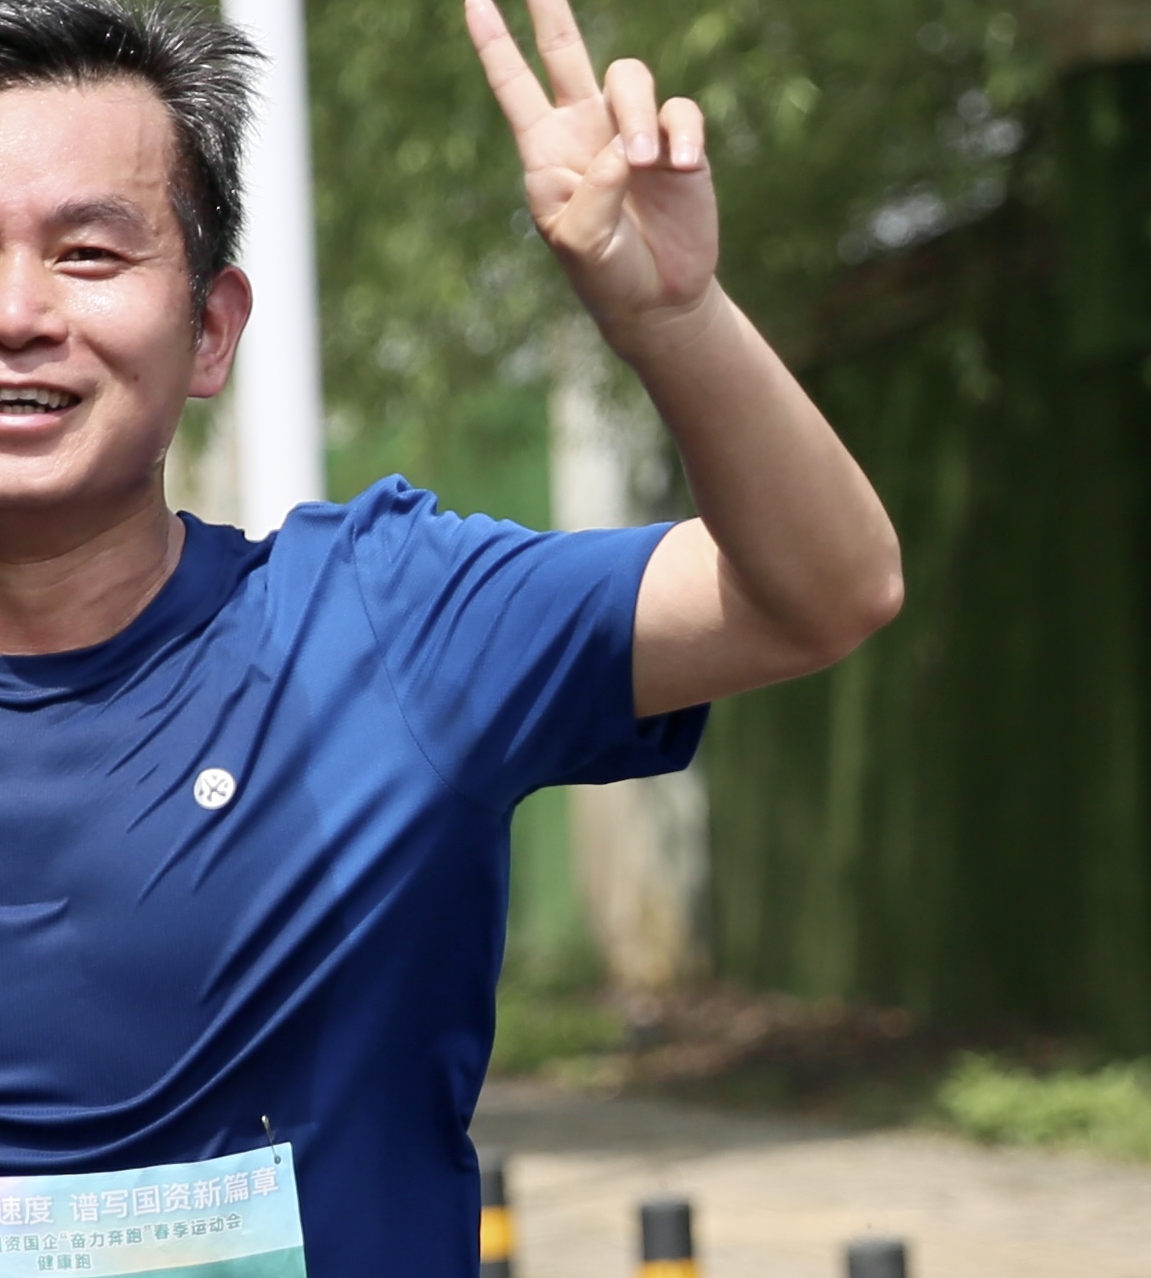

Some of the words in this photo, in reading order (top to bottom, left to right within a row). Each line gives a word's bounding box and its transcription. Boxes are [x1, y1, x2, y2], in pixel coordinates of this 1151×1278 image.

[69, 1166, 279, 1222] 谱写国资新篇章
[37, 1253, 91, 1271] 健康跑
